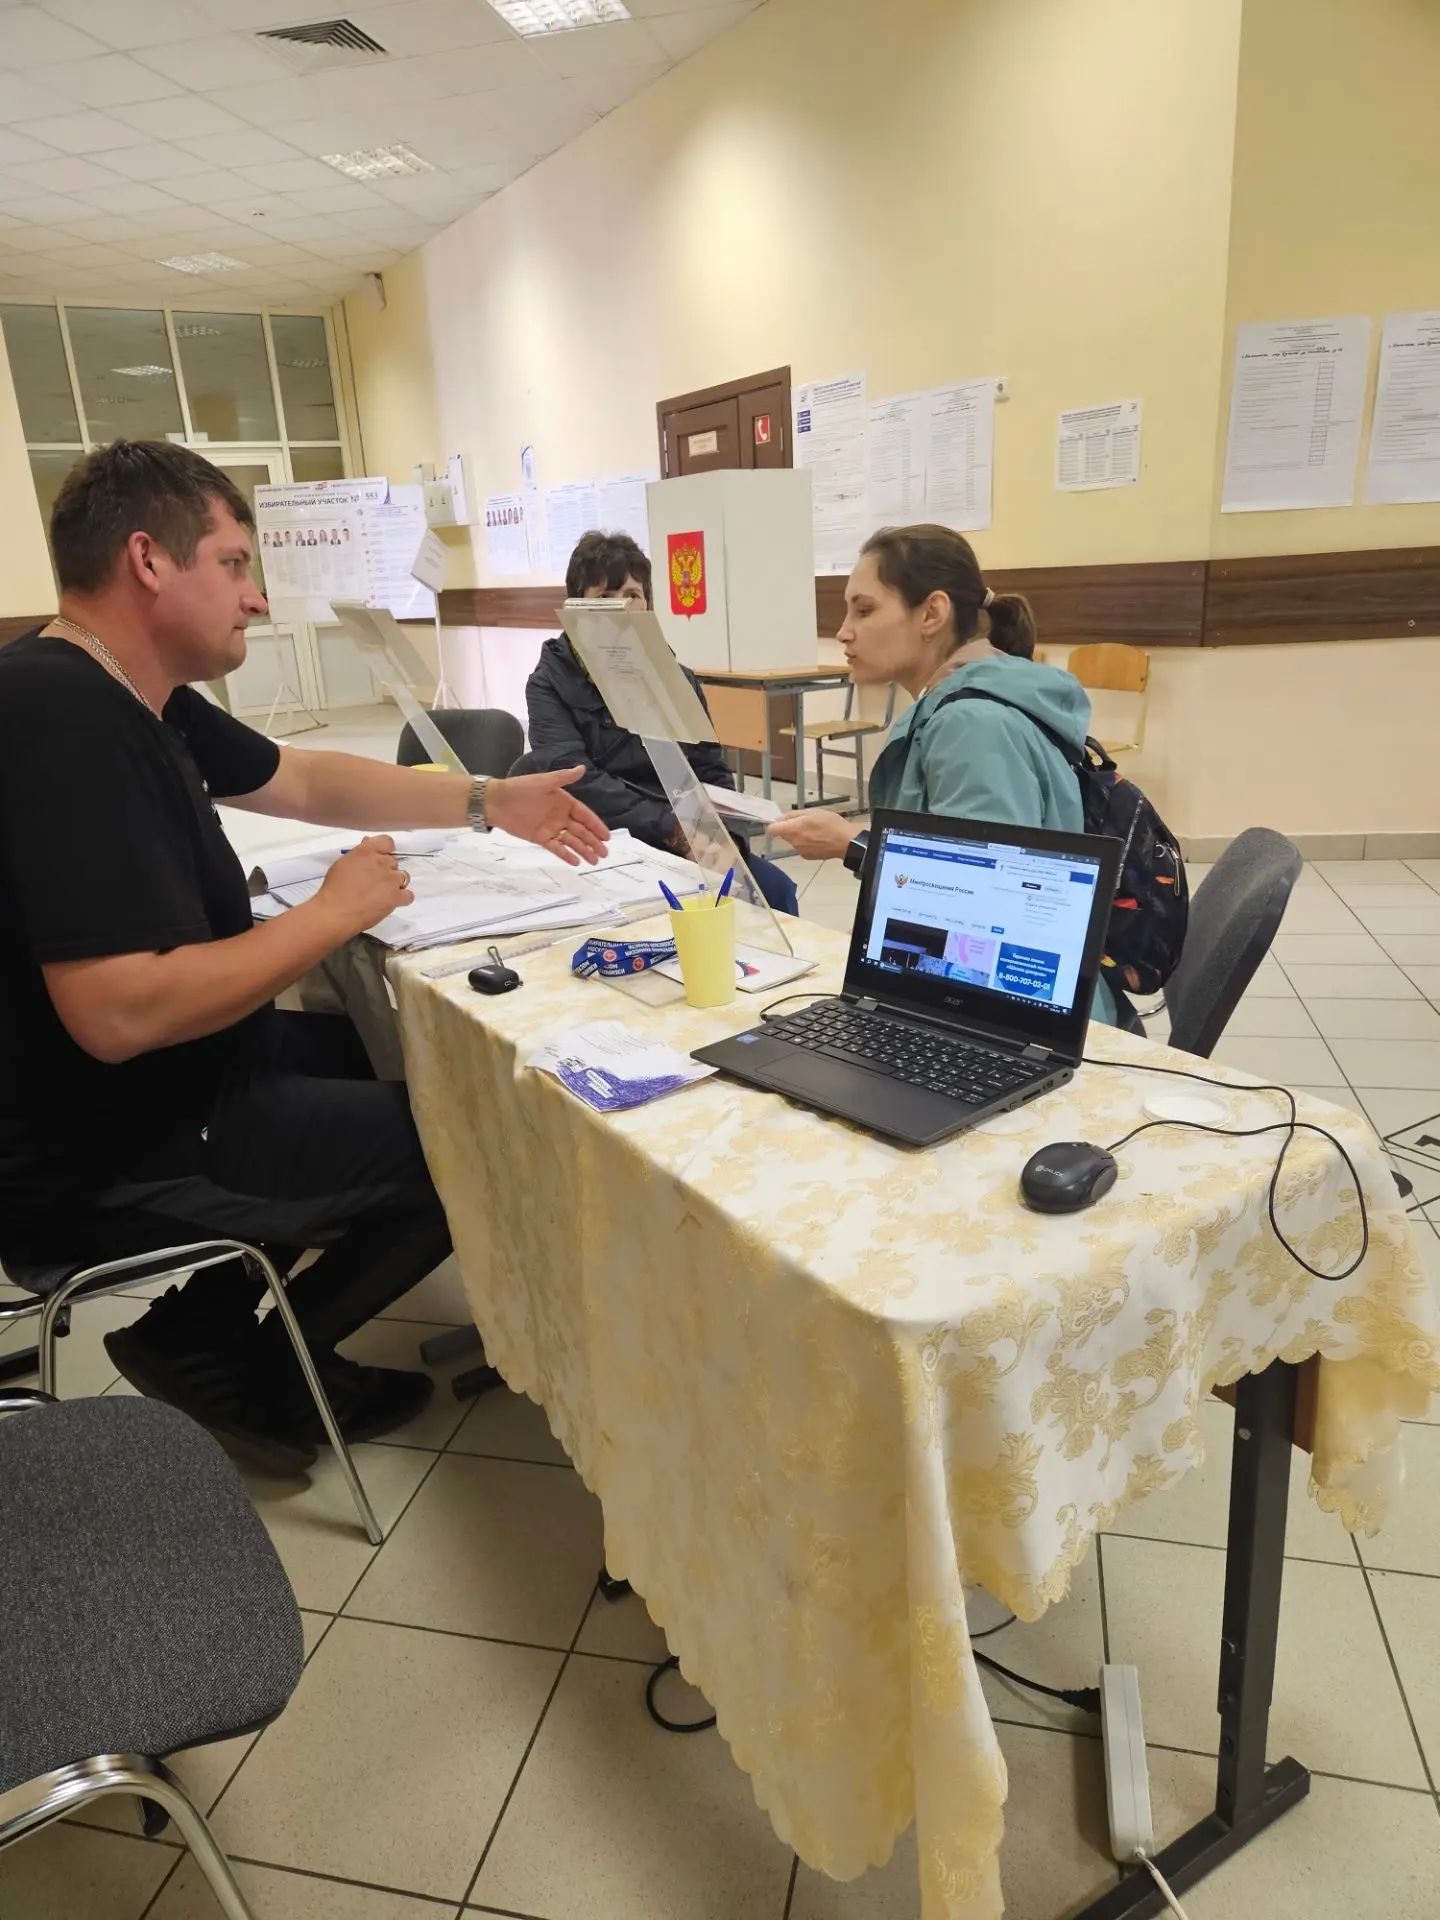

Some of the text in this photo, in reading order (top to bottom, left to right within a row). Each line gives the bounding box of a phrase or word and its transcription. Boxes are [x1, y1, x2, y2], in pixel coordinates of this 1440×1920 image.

[259, 499, 317, 508] ИЗБИРАТЕЛЬНЫЙ
[318, 497, 348, 505] УЧАСТОК
[910, 878, 954, 891] Минпросвещения
[954, 886, 974, 895] России
[999, 972, 1051, 990] 8-800-707-02-01
